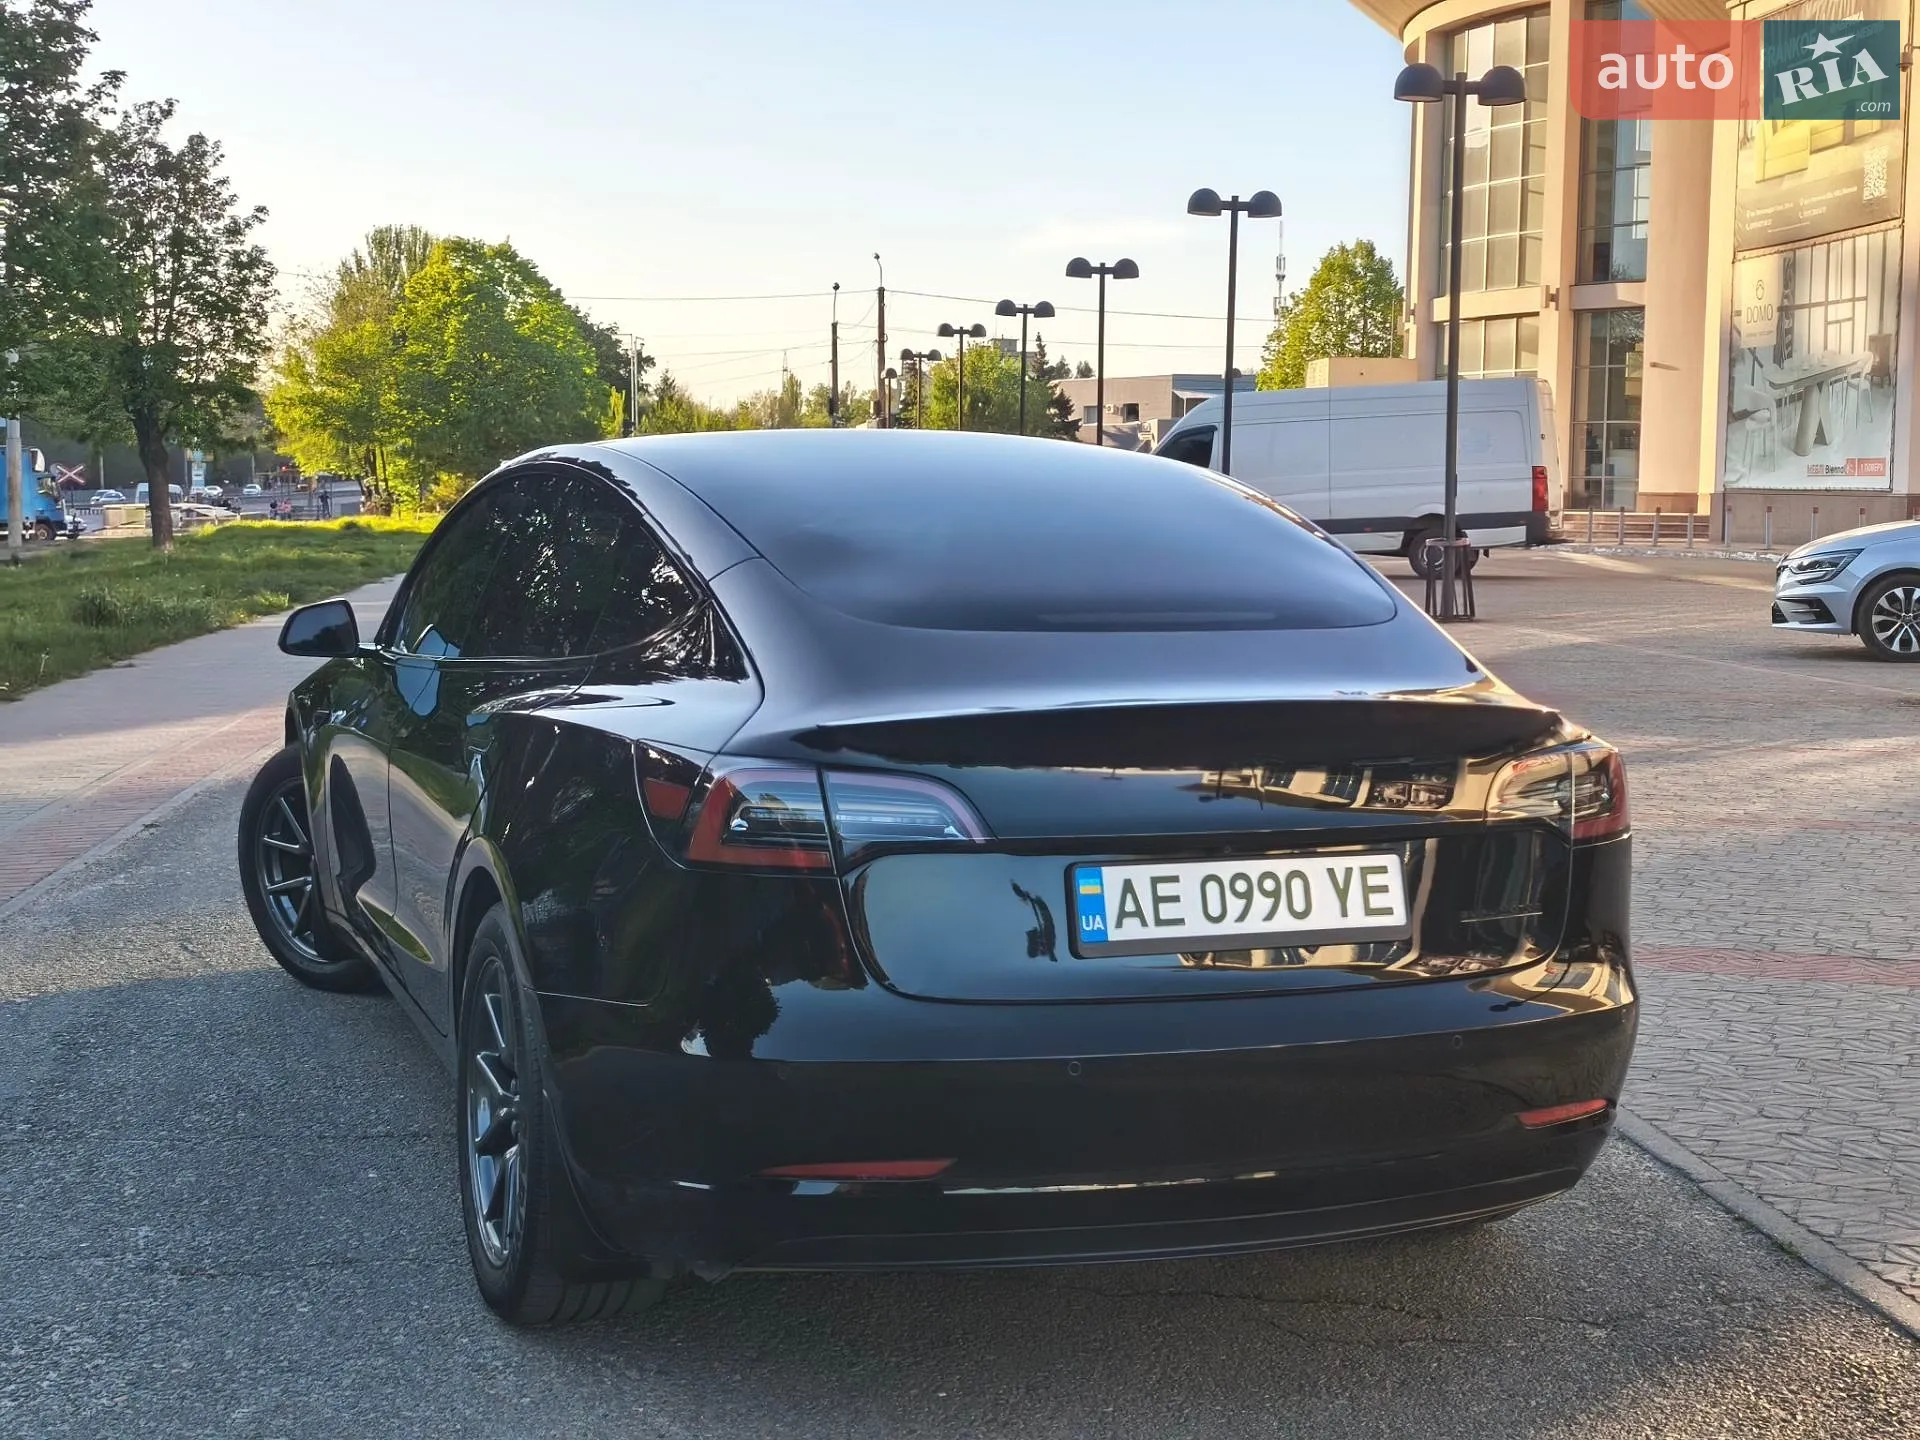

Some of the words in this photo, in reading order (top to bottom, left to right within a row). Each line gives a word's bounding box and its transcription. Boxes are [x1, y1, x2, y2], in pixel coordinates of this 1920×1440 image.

[1746, 303, 1774, 324] DOMO
[1115, 875, 1185, 929] AE
[1199, 869, 1312, 925] 0990
[1326, 865, 1394, 918] YE
[1081, 914, 1105, 932] UA
